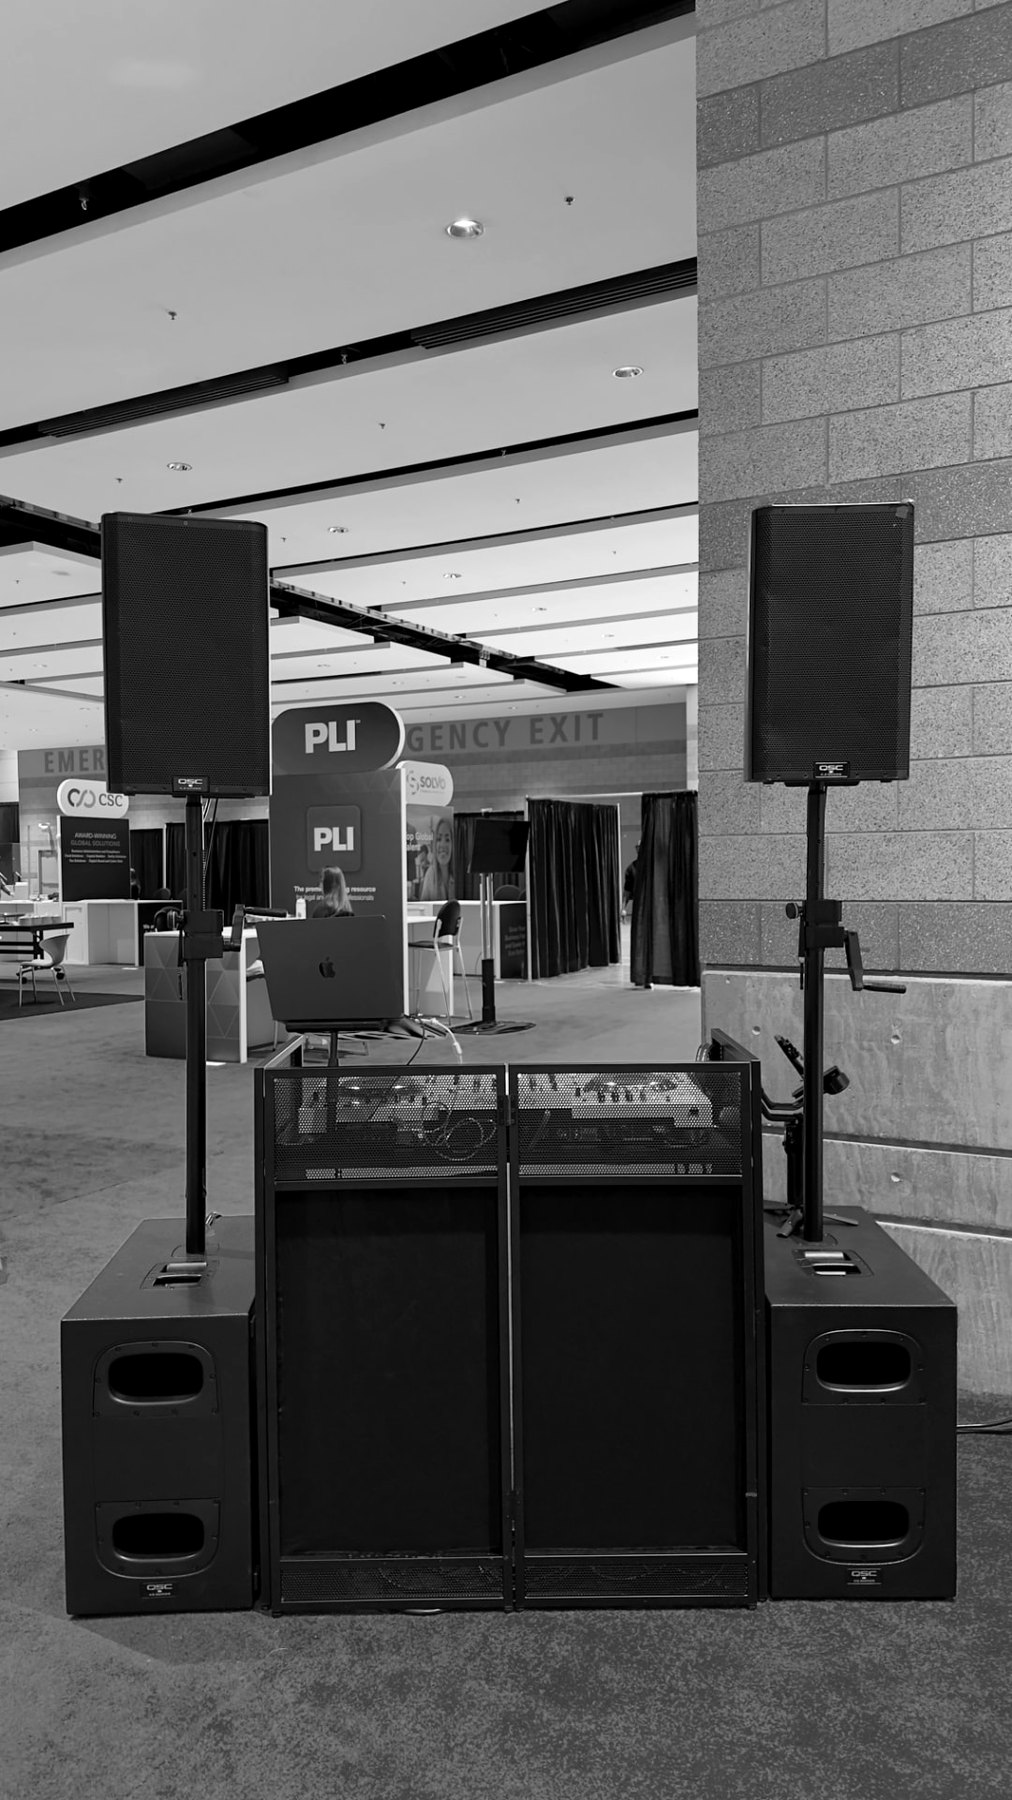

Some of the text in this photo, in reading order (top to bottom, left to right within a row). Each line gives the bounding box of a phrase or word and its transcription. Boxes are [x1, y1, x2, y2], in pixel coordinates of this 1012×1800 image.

[530, 713, 604, 745] EXIT
[98, 793, 123, 807] CSC
[313, 826, 355, 852] PLI
